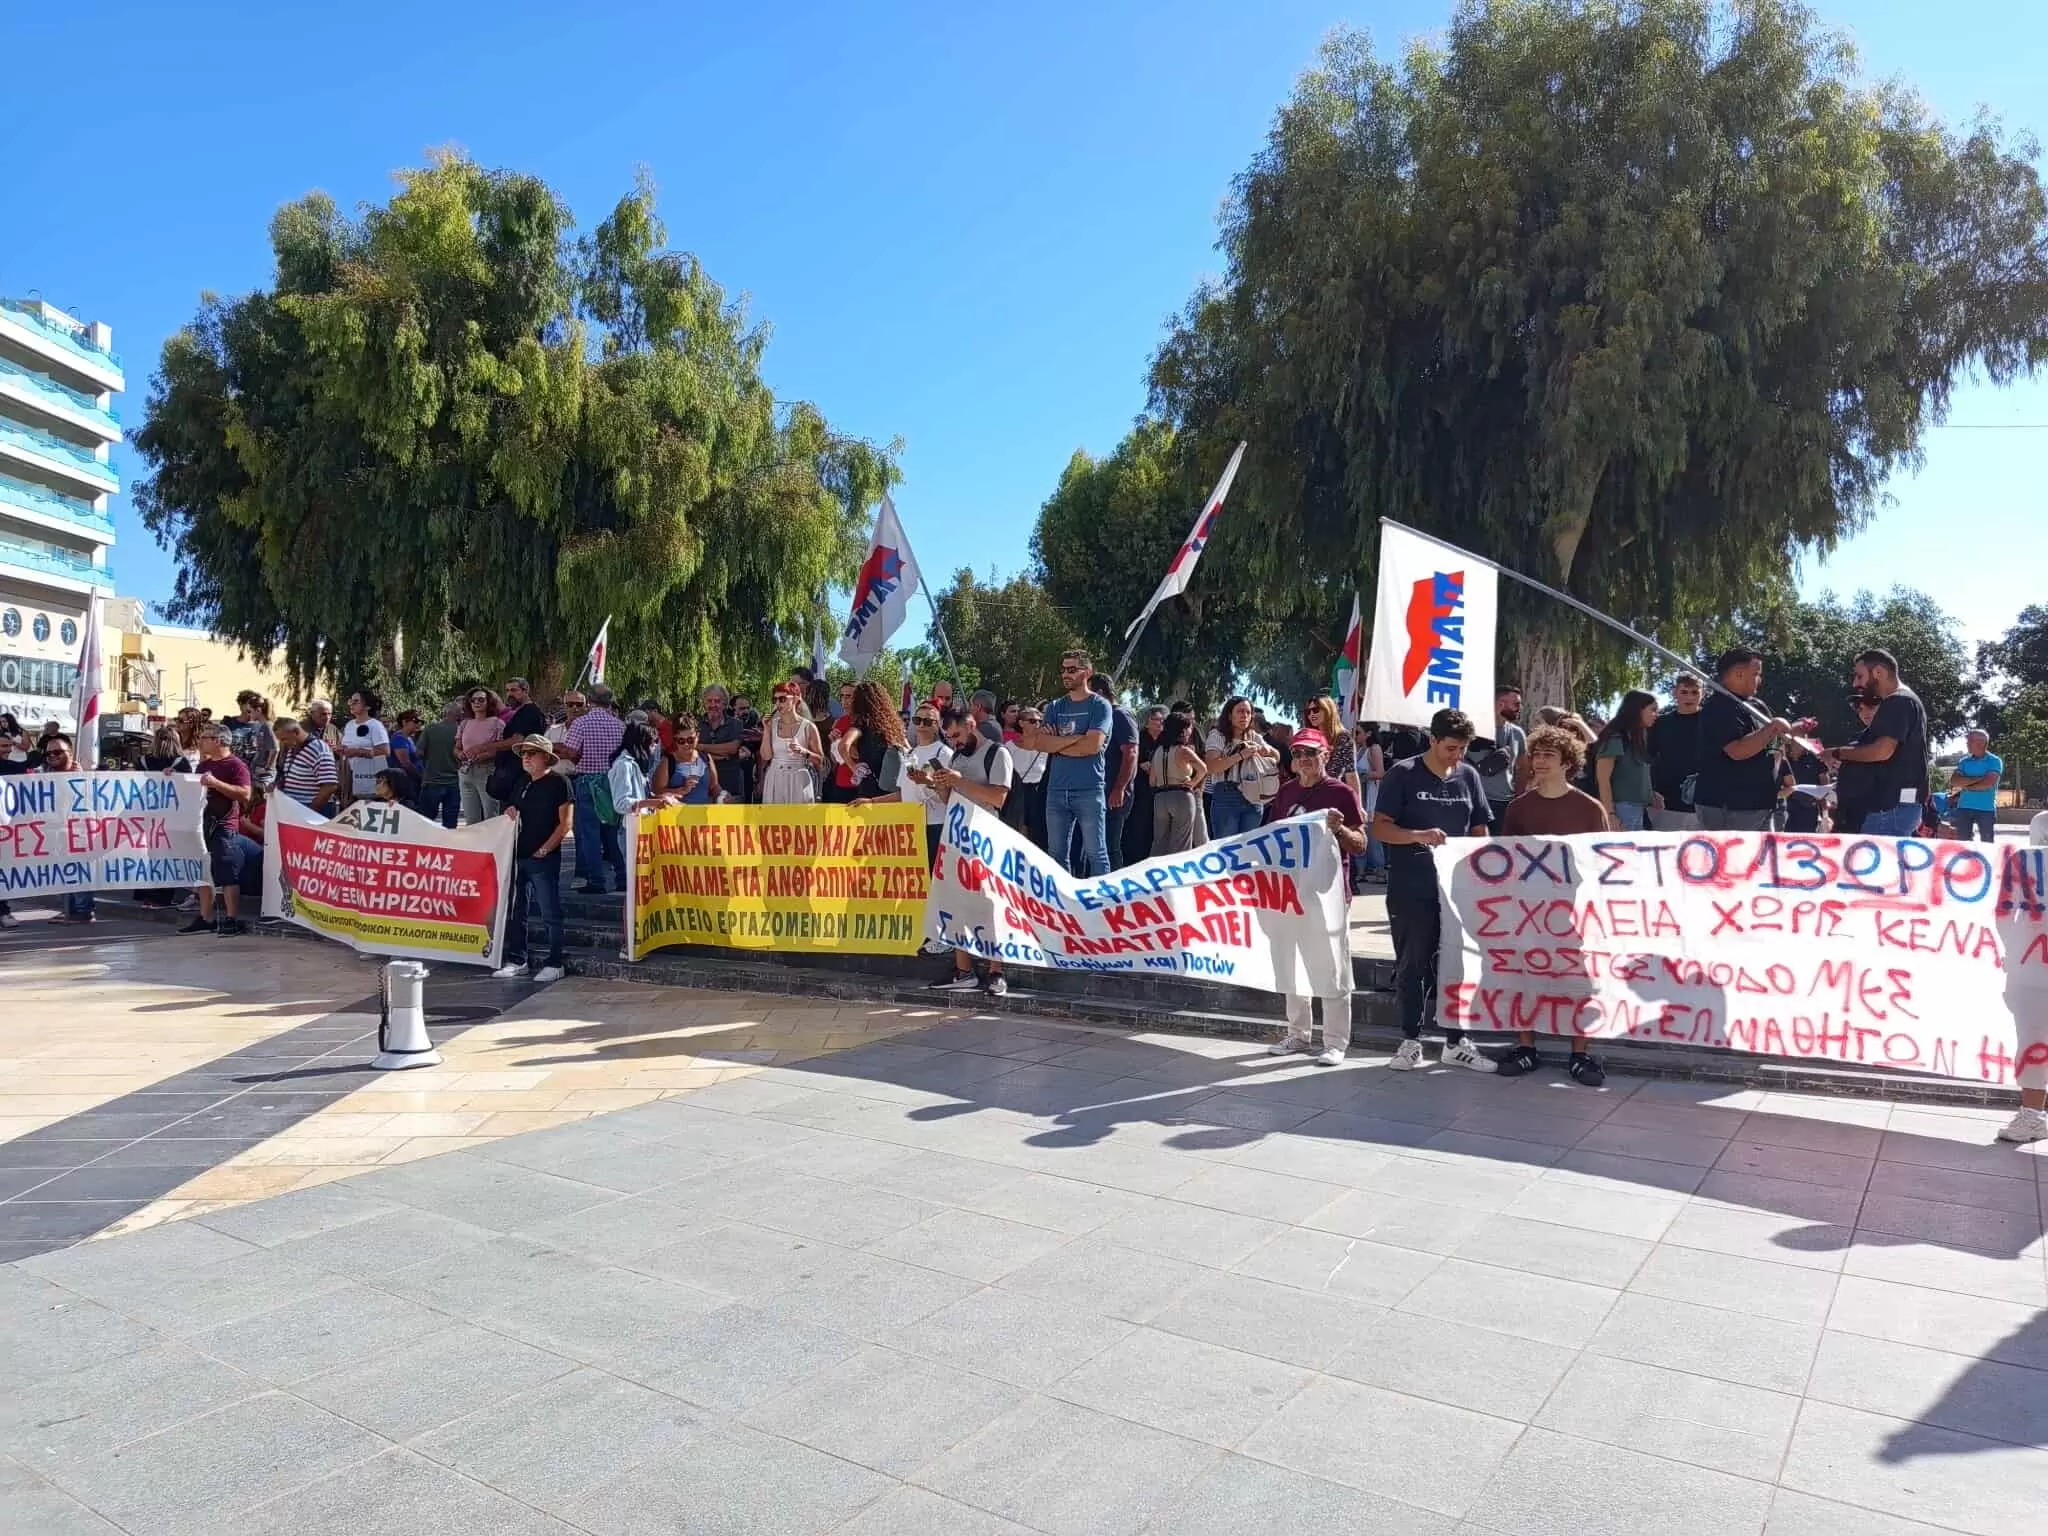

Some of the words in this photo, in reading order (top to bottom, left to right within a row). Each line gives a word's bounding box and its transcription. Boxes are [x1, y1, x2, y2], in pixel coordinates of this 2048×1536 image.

[0, 779, 55, 816] ΟΝΗ
[68, 777, 180, 812] ΣΚΛΑΒΙΑ
[66, 816, 172, 853] ΕΡΓΑΣΙΑ
[657, 825, 722, 856] ΜΙΛΑΤΕ
[726, 825, 755, 855] ΓΙΑ
[759, 825, 818, 856] ΚΕΡΔΗ
[822, 824, 850, 856] ΚΑΙ
[853, 824, 918, 856] ΖΗΜΙΕΣ
[105, 858, 203, 883] ΗΡΑΚΛΕΙΟΥ
[313, 836, 337, 856] ΜΕ
[416, 850, 454, 872] ΜΑΣ
[1001, 849, 1025, 886] ΔΕ
[1030, 861, 1064, 910] ΘΑ
[1075, 824, 1312, 911] ΕΦΑΡΜΟΣΤΕΙ
[1470, 843, 1572, 884] ΟΧΙ
[297, 875, 327, 896] ΠΟΥ
[386, 870, 480, 897] ΠΟΛΙΤΙΚΕΣ
[661, 865, 730, 896] ΜΙΛΑΜΕ
[733, 866, 761, 896] ΓΙΑ
[767, 866, 878, 898] ΑΝΘΡΩΠΙΝΕΣ
[881, 867, 929, 899] ΖΩΕΣ
[957, 855, 1085, 936] ΟΡΓΑΝΩΣΗ
[1103, 896, 1175, 934] ΚΑΙ
[1193, 870, 1304, 915] ΑΓΩΝΑ
[392, 926, 438, 942] ΣΥΛΛΟΓΩΝ
[439, 932, 481, 945] ΗΡΑΚΛΕΙΟΥ
[717, 911, 848, 938] ΕΡΓΑΖΟΜΕΝΩΝ
[855, 914, 913, 941] ΠΑΓΝΗ
[938, 910, 1043, 962] Συνδικάτο
[1181, 951, 1236, 977] Ποτών
[1005, 906, 1041, 943] ΘΑ
[1063, 911, 1252, 955] ΑΝΑΤΡΑΠΕΙ
[1475, 895, 1681, 939] ΣΧΟΛΕΙΑ
[1874, 910, 2005, 969] ΚΕΝΑ
